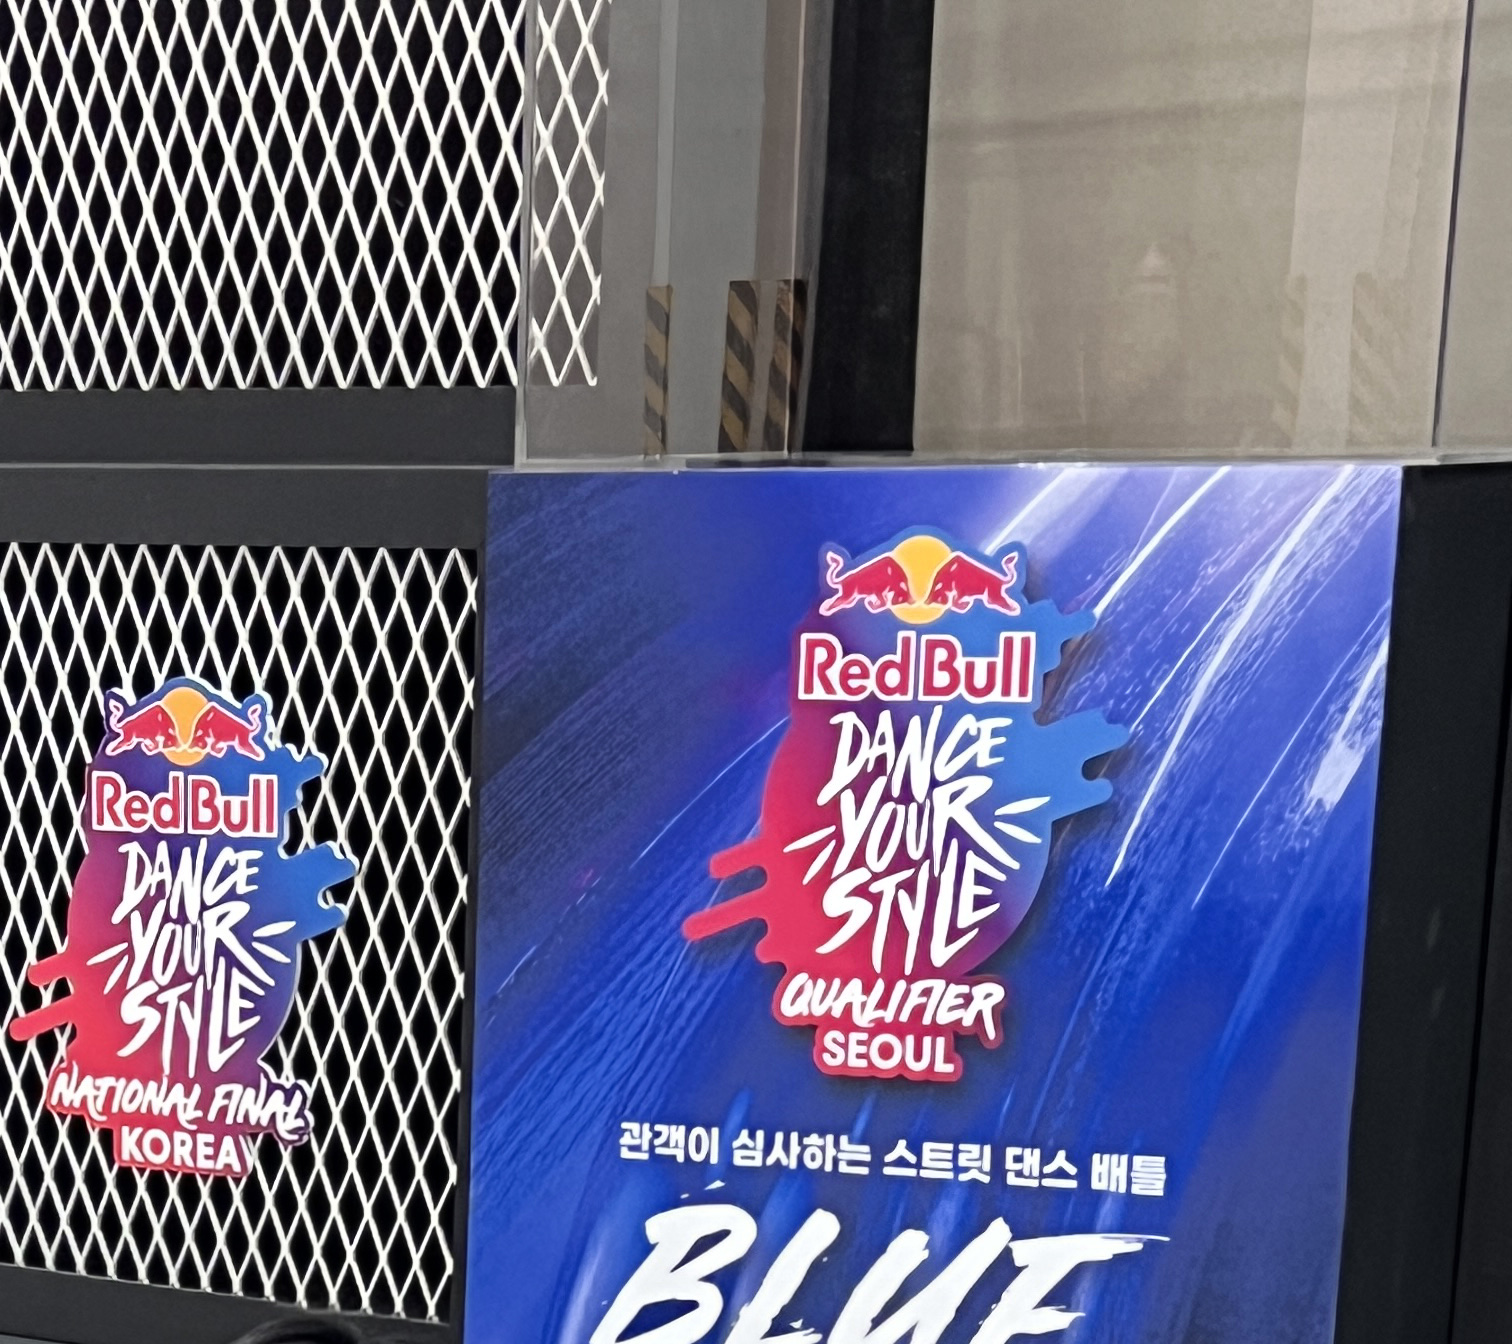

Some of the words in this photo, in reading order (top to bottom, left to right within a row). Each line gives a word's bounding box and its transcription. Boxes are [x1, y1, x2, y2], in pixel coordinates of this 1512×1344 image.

[799, 631, 916, 700] Red
[918, 631, 1036, 702] Bull
[817, 705, 1013, 805] DANCE
[92, 772, 185, 833] Red
[187, 774, 279, 837] Bull
[832, 778, 1019, 880] YOUR
[113, 841, 263, 924] DANCE
[816, 839, 1006, 974] STYLE
[128, 901, 275, 989] YOUR
[117, 957, 265, 1078] STYLE
[780, 972, 1005, 1039] QUALIFIER
[822, 1030, 955, 1074] SEOUL
[52, 1072, 204, 1130] NATIONAL
[208, 1082, 308, 1140] FINAL
[121, 1129, 240, 1171] KOREA
[620, 1121, 719, 1164] 관객이
[731, 1130, 869, 1175] 심사하는
[882, 1138, 990, 1185] 스트릿
[1005, 1145, 1078, 1189] 댄스
[1090, 1152, 1166, 1196] 배틀
